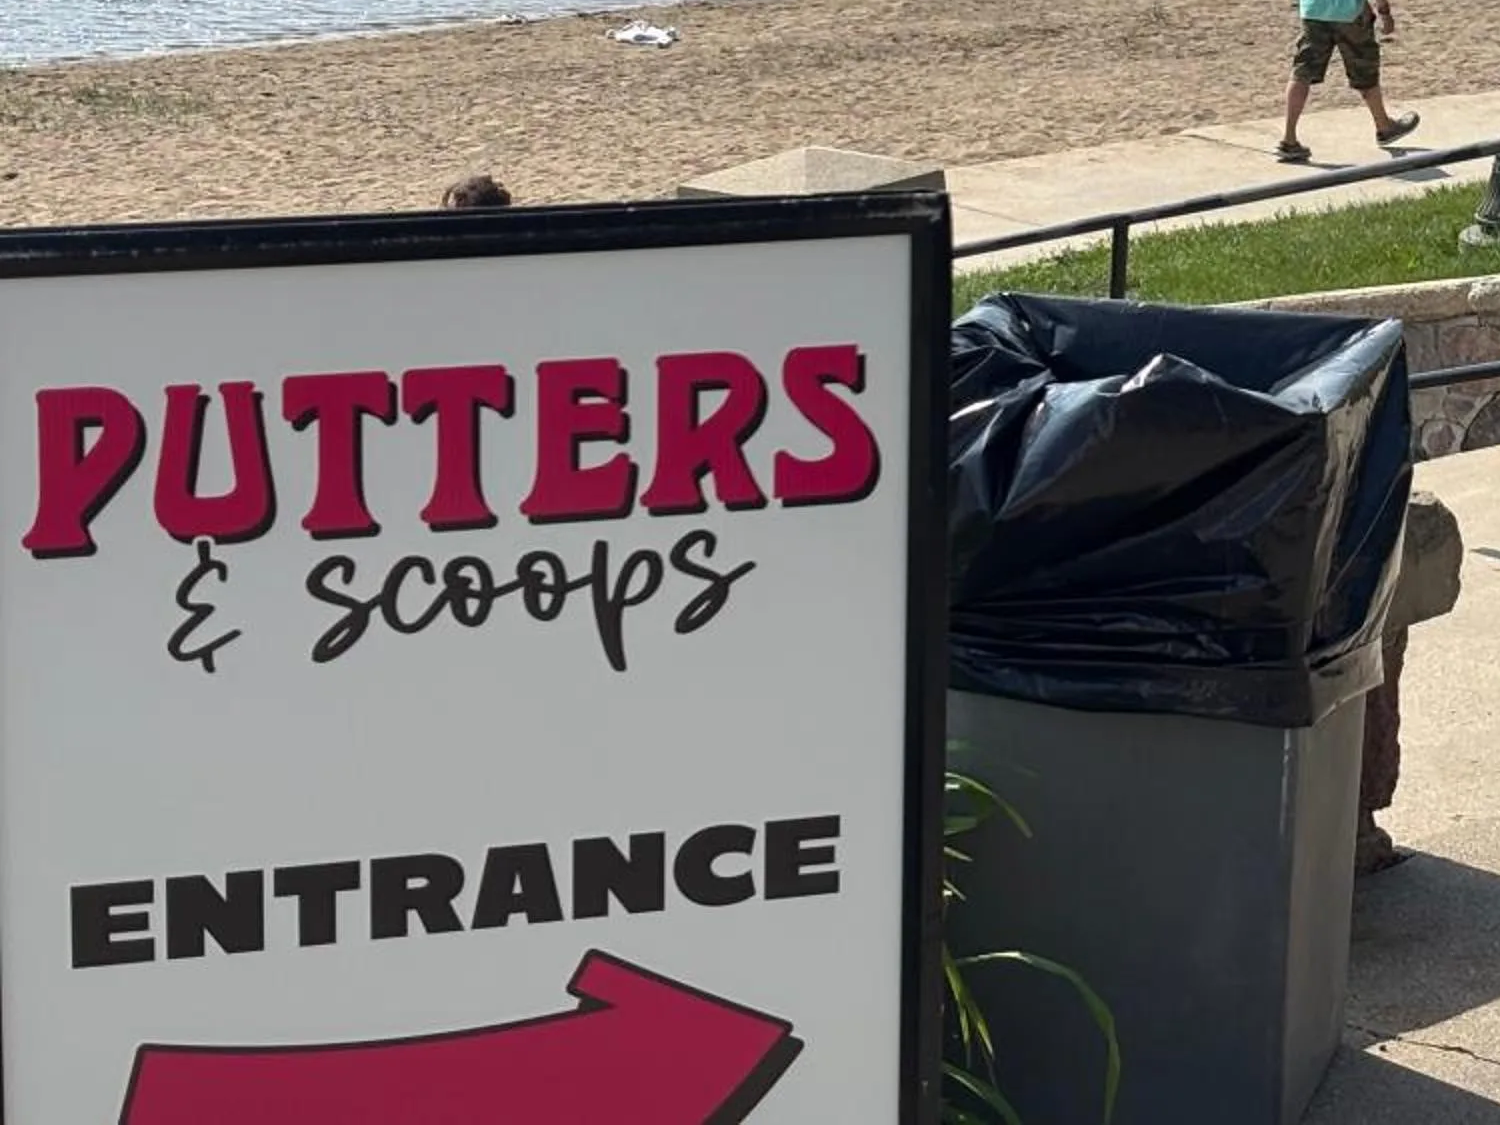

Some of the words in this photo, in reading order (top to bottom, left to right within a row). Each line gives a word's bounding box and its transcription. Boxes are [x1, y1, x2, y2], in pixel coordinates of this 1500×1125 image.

[22, 345, 881, 559] PUTTERS
[168, 538, 241, 673] &
[71, 815, 840, 969] ENTRANCE
